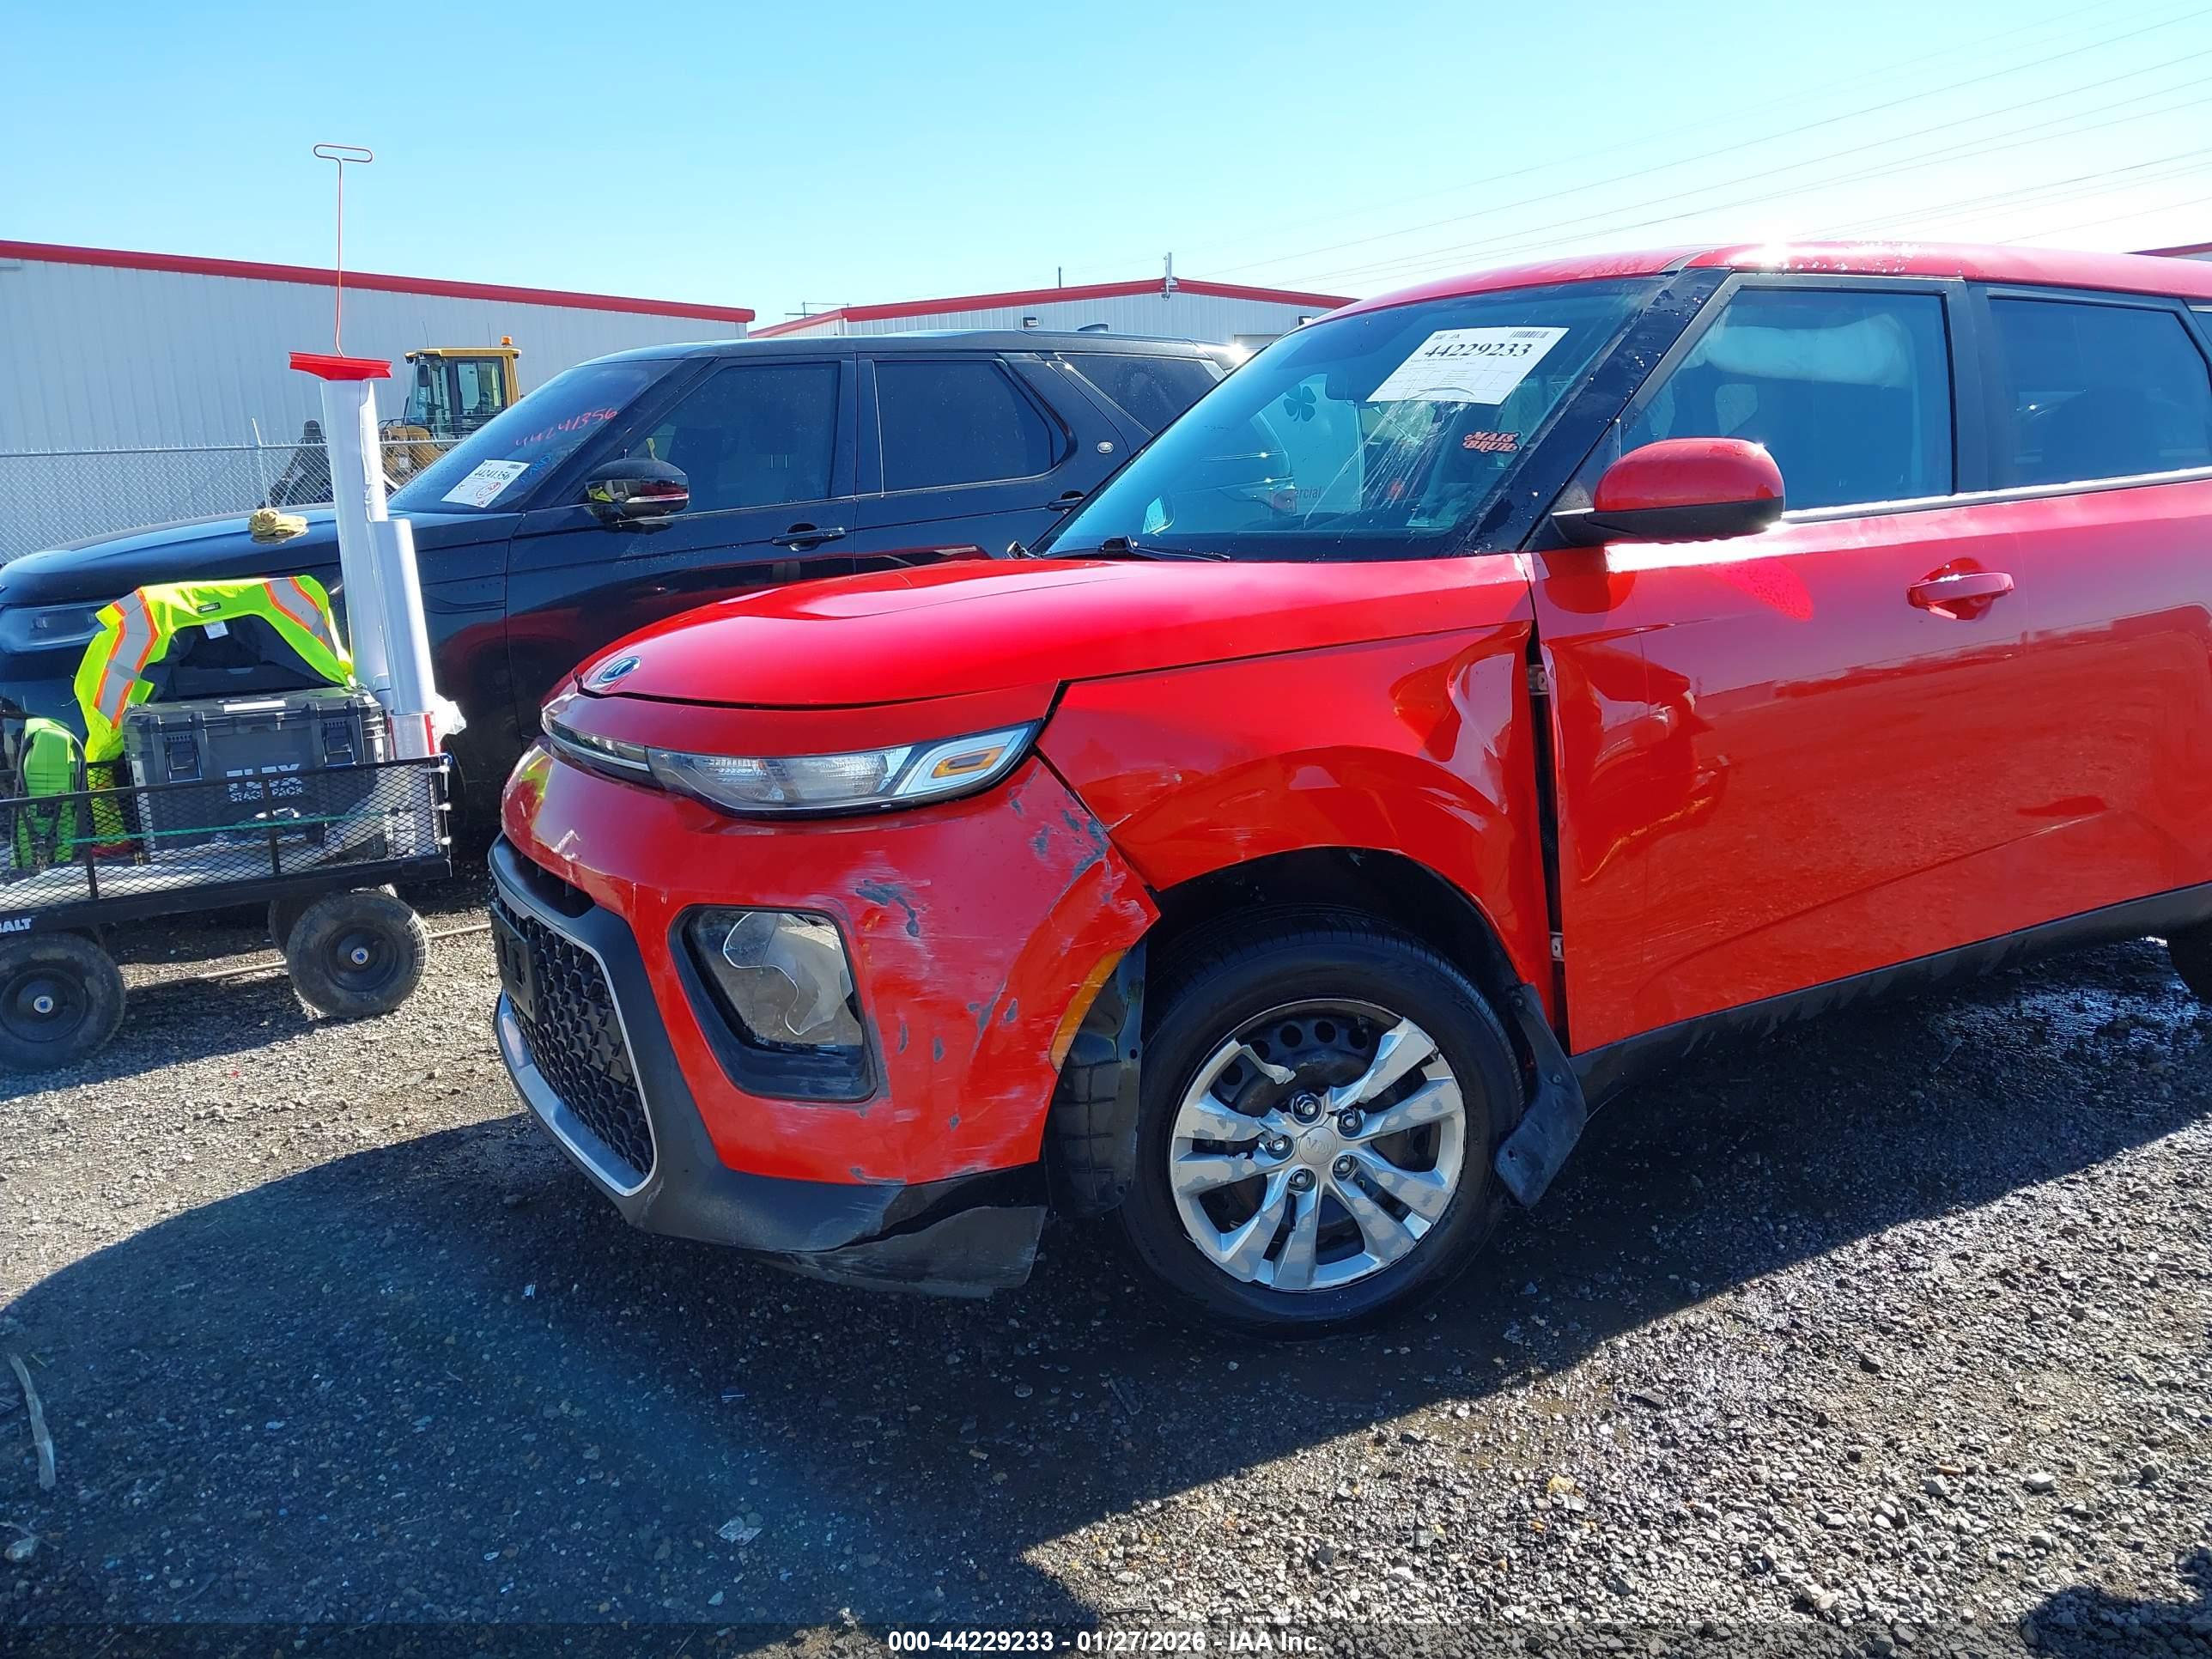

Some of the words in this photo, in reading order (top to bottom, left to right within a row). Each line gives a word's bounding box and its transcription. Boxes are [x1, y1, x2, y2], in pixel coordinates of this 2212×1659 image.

[1424, 343, 1533, 357] 44229233
[1464, 431, 1520, 442] MAIS
[1462, 440, 1518, 453] BRUH
[0, 918, 32, 933] ALT
